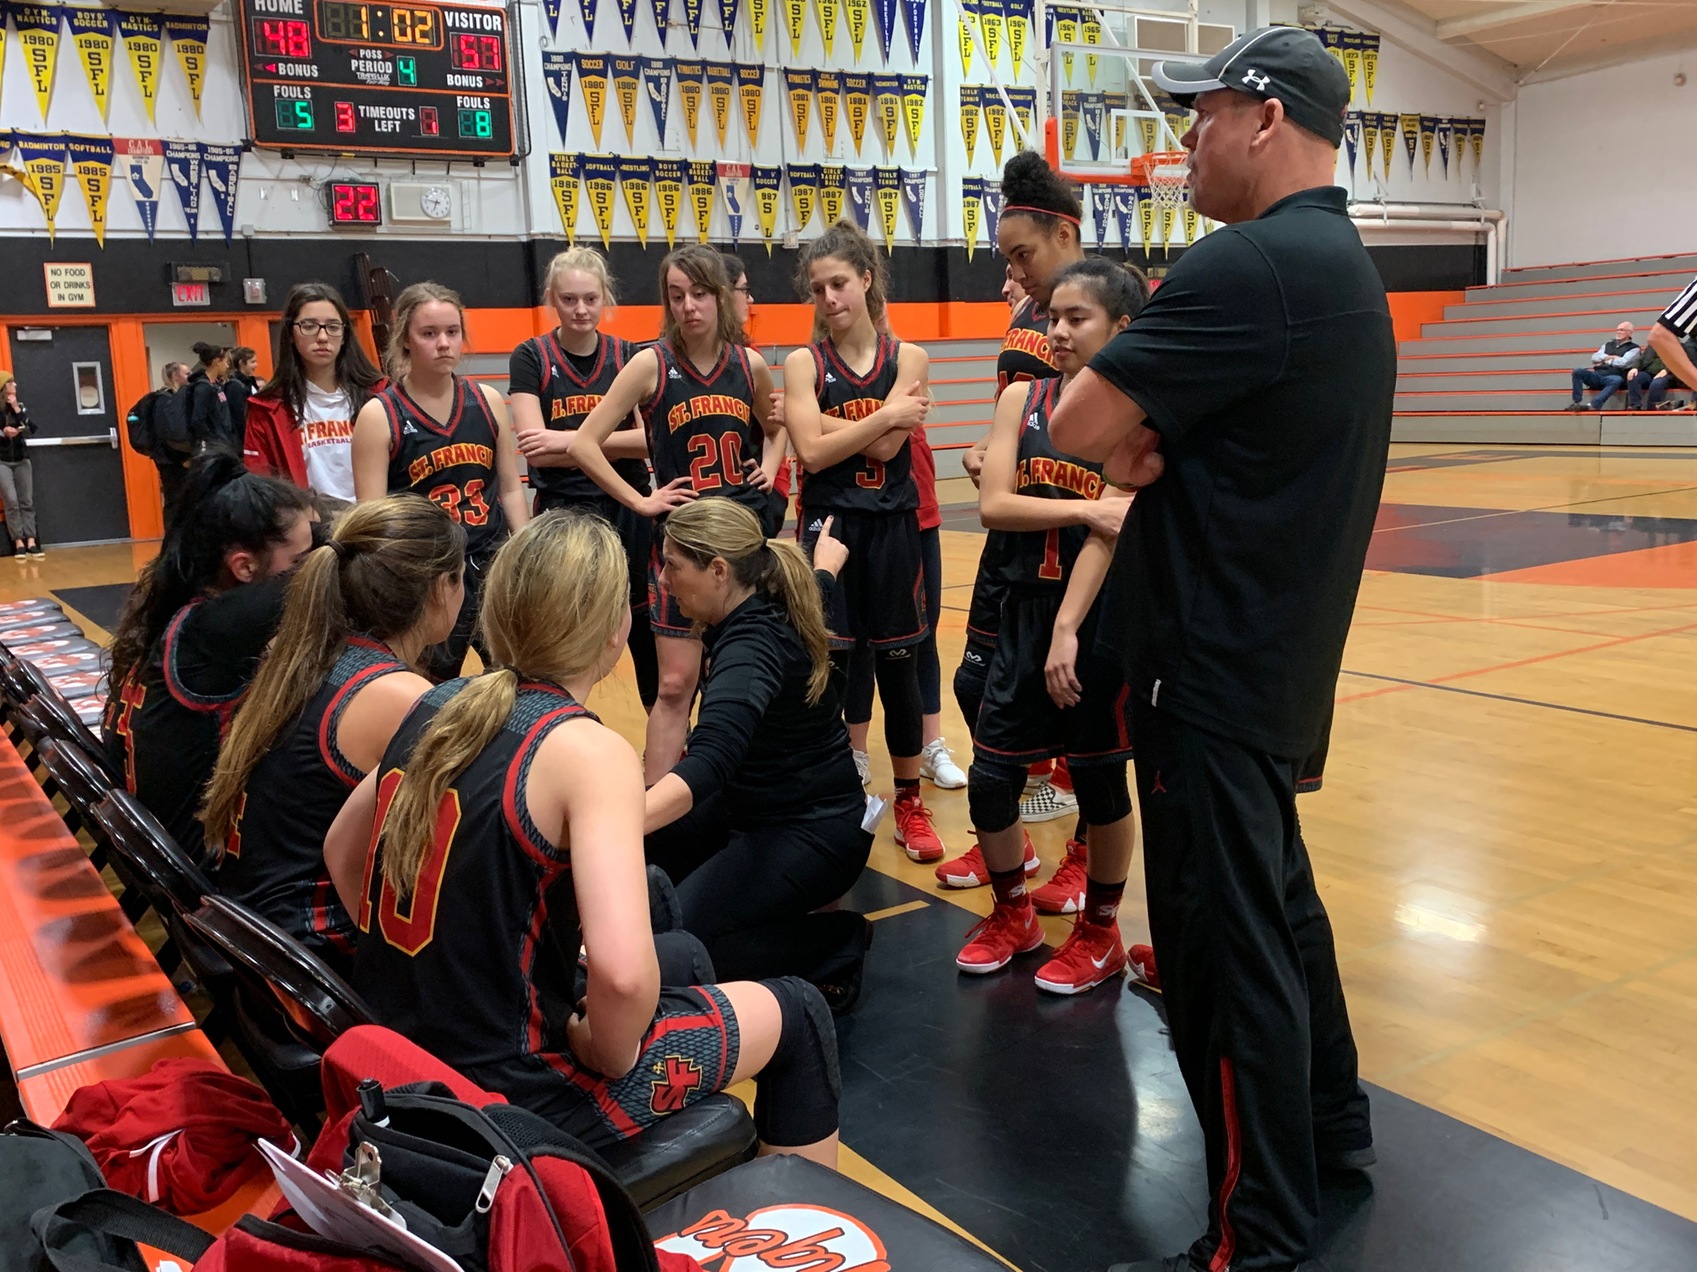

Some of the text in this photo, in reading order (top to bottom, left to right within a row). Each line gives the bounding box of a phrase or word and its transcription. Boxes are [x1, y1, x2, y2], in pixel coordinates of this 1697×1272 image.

[255, 0, 303, 14] HOME
[74, 18, 108, 28] SOCCER
[121, 22, 158, 32] NASTICS
[166, 22, 208, 30] BADMINTON
[361, 6, 433, 44] 1:02
[445, 12, 502, 31] VISITOR
[984, 18, 1002, 26] 1963
[24, 34, 54, 46] 1980
[264, 21, 309, 56] 48
[79, 39, 109, 50] 1980
[128, 41, 158, 52] 1980
[176, 44, 204, 54] 1980
[360, 49, 382, 60] POSS
[459, 34, 500, 70] 57
[351, 60, 392, 74] PERIOD
[581, 59, 604, 70] SOCCER
[616, 60, 636, 70] GOLF
[278, 63, 318, 78] BONUS
[400, 59, 414, 84] 4
[740, 69, 760, 79] SOCCER
[447, 74, 483, 88] BONUS
[584, 80, 604, 90] 1980
[617, 81, 636, 90] 1980
[846, 78, 866, 88] SOCCER
[274, 86, 311, 98] FOULS
[682, 85, 700, 94] 1980
[711, 86, 730, 95] 1980
[742, 88, 760, 97] 1980
[457, 96, 490, 109] FOULS
[792, 94, 809, 102] 1981
[820, 96, 836, 104] 1981
[295, 101, 313, 128] 5
[336, 102, 354, 131] 3
[358, 106, 416, 120] TIMEOUTS
[374, 120, 401, 132] LEFT
[475, 111, 490, 137] 8
[18, 140, 66, 151] BADMINTON
[69, 143, 112, 154] SOFTBALL
[166, 150, 200, 160] CHAMPIONS
[204, 154, 240, 162] CHAMPIONS
[31, 164, 60, 174] 1985
[78, 166, 106, 177] 1985
[554, 180, 578, 188] 1986
[590, 182, 612, 190] 1986
[625, 182, 648, 190] 1986
[658, 184, 680, 192] 1986
[794, 188, 814, 196] 1987
[822, 190, 842, 198] 1987
[880, 192, 898, 200] 1987
[334, 186, 378, 220] 22
[51, 268, 86, 277] NO FOOD
[50, 281, 90, 290] OR DRINKS
[68, 294, 84, 302] GYM
[176, 284, 204, 302] EXIT
[668, 401, 692, 434] ST.
[688, 431, 744, 492] 20
[408, 455, 434, 487] ST.
[1030, 457, 1106, 500] FRANC
[429, 479, 490, 526] 33
[1038, 527, 1062, 580] 1
